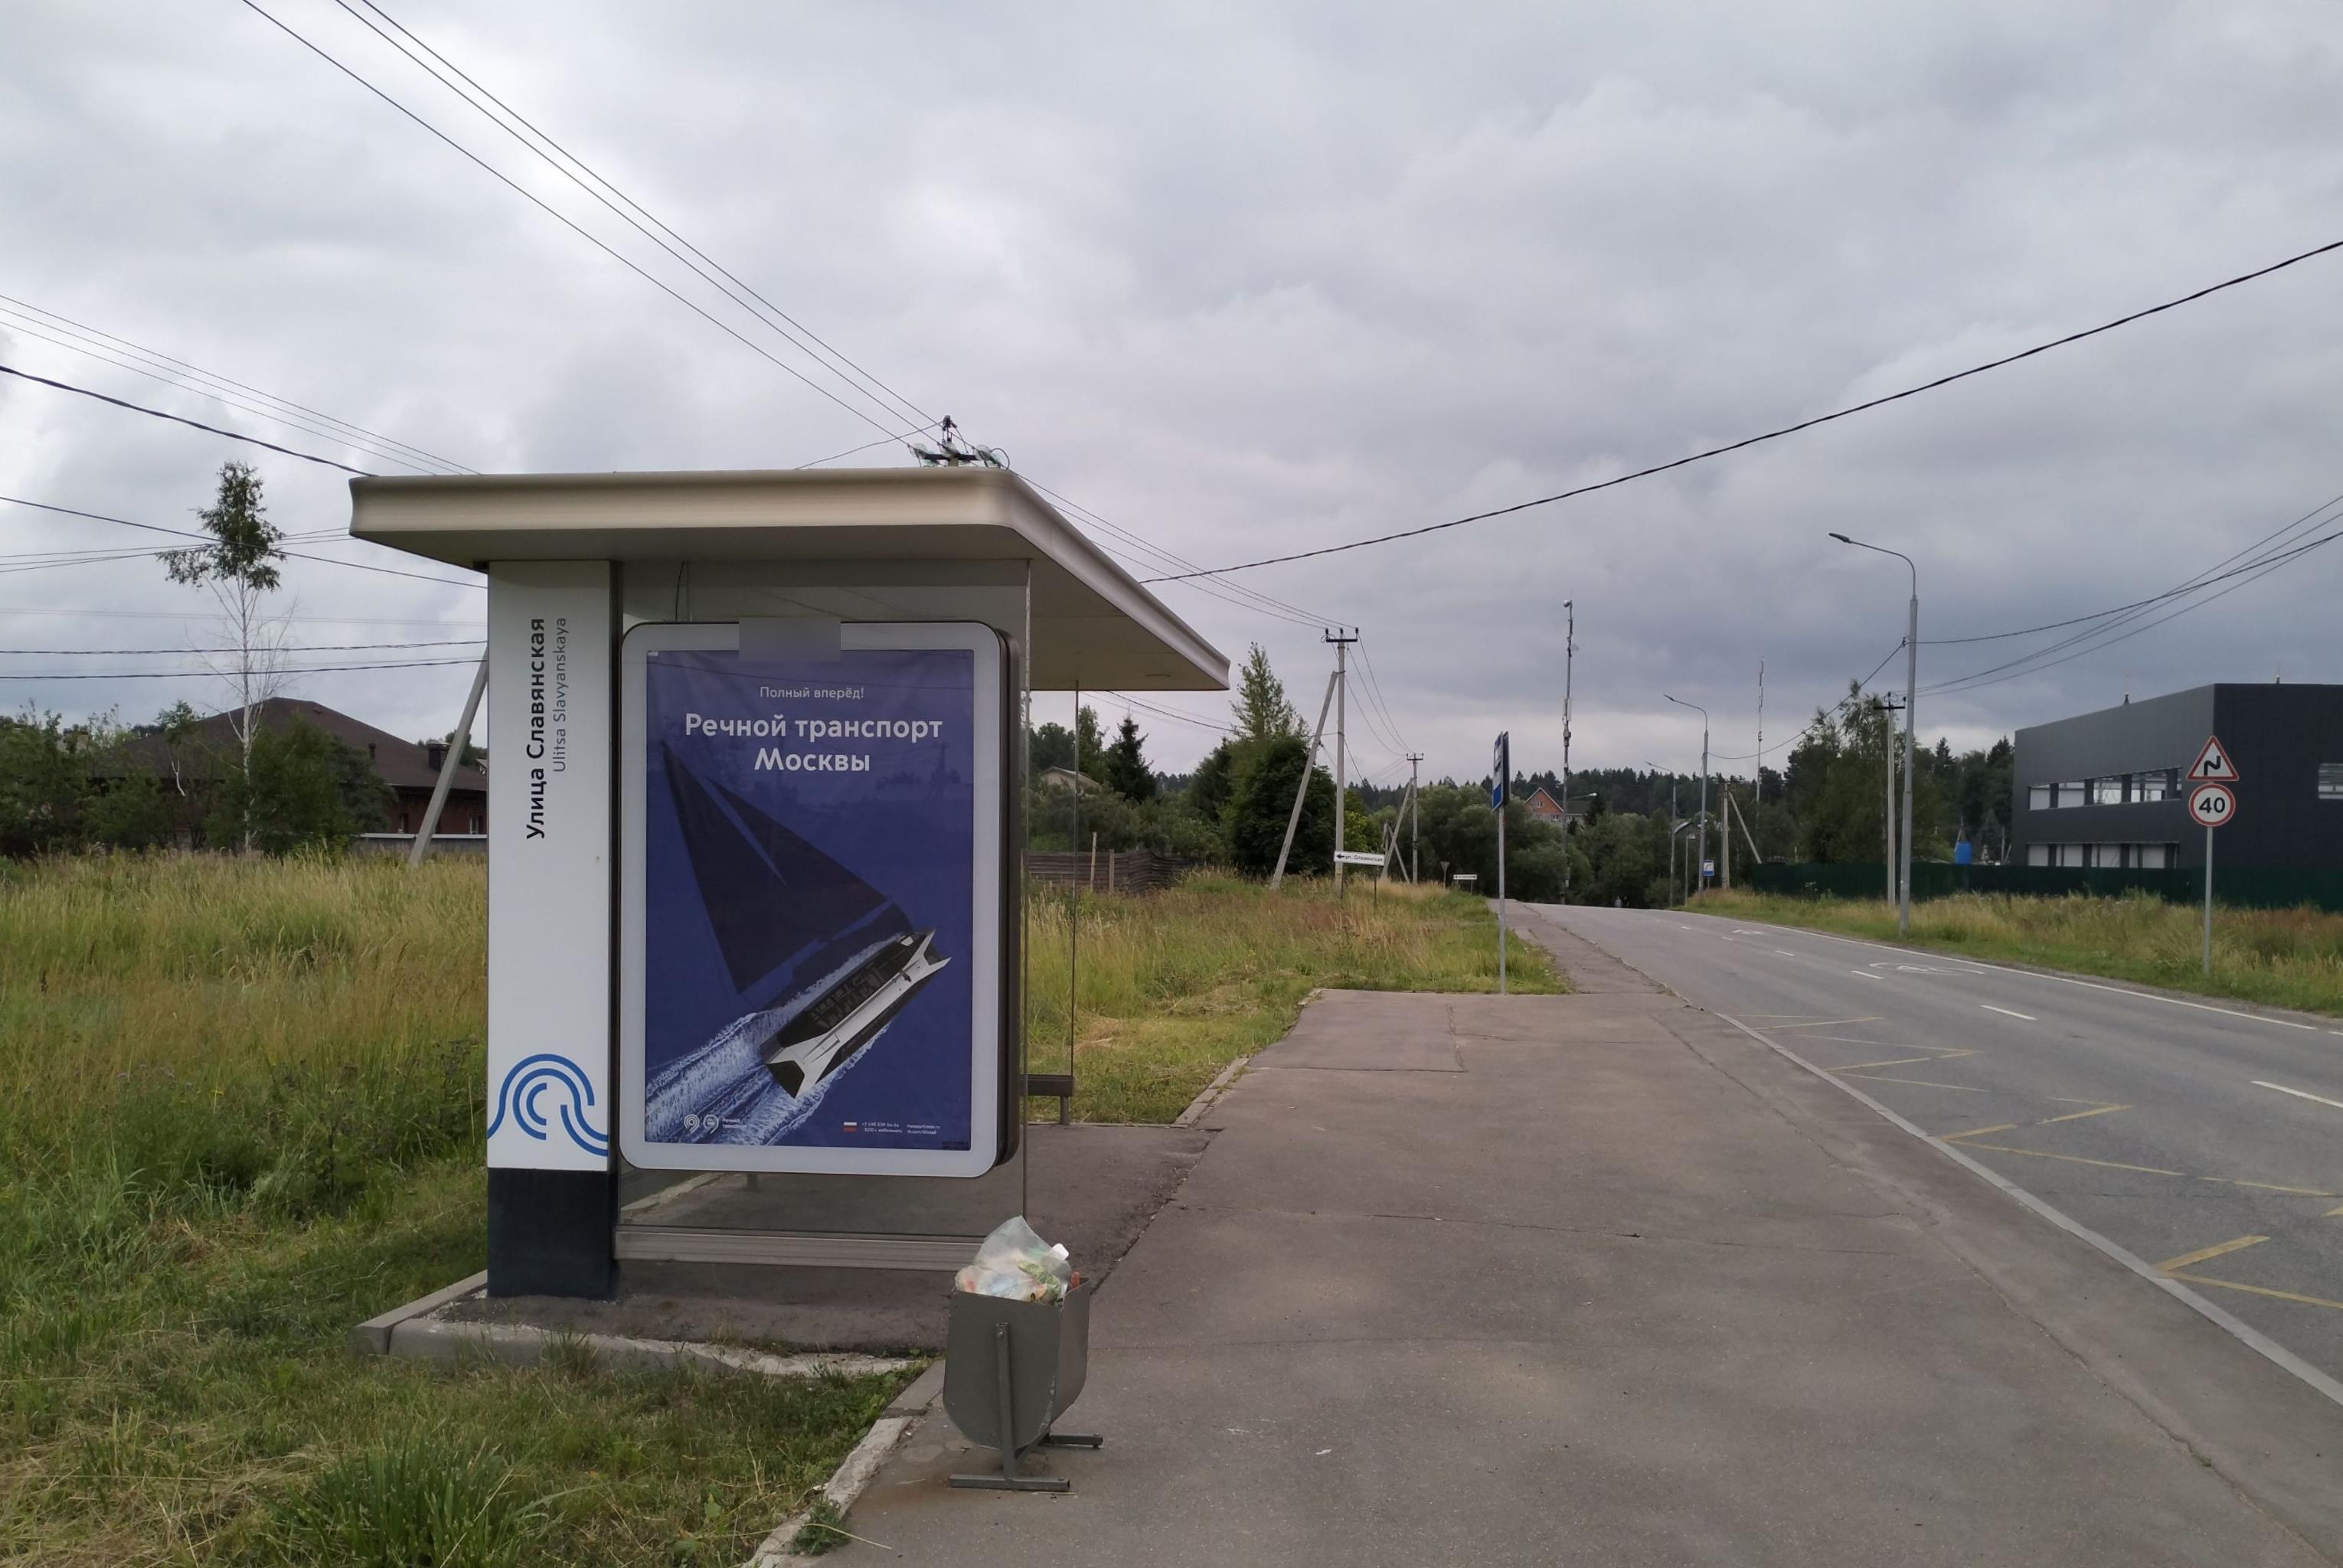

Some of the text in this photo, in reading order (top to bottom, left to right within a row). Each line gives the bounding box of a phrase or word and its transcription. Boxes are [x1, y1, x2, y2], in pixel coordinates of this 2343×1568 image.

[552, 618, 569, 773] Ulitsa Slavyanskaya
[760, 686, 864, 700] Полный вперёд!
[526, 619, 547, 839] Улица Славянская
[685, 713, 943, 743] Речной транспорт
[754, 747, 871, 772] Москвы
[2198, 797, 2226, 814] 40
